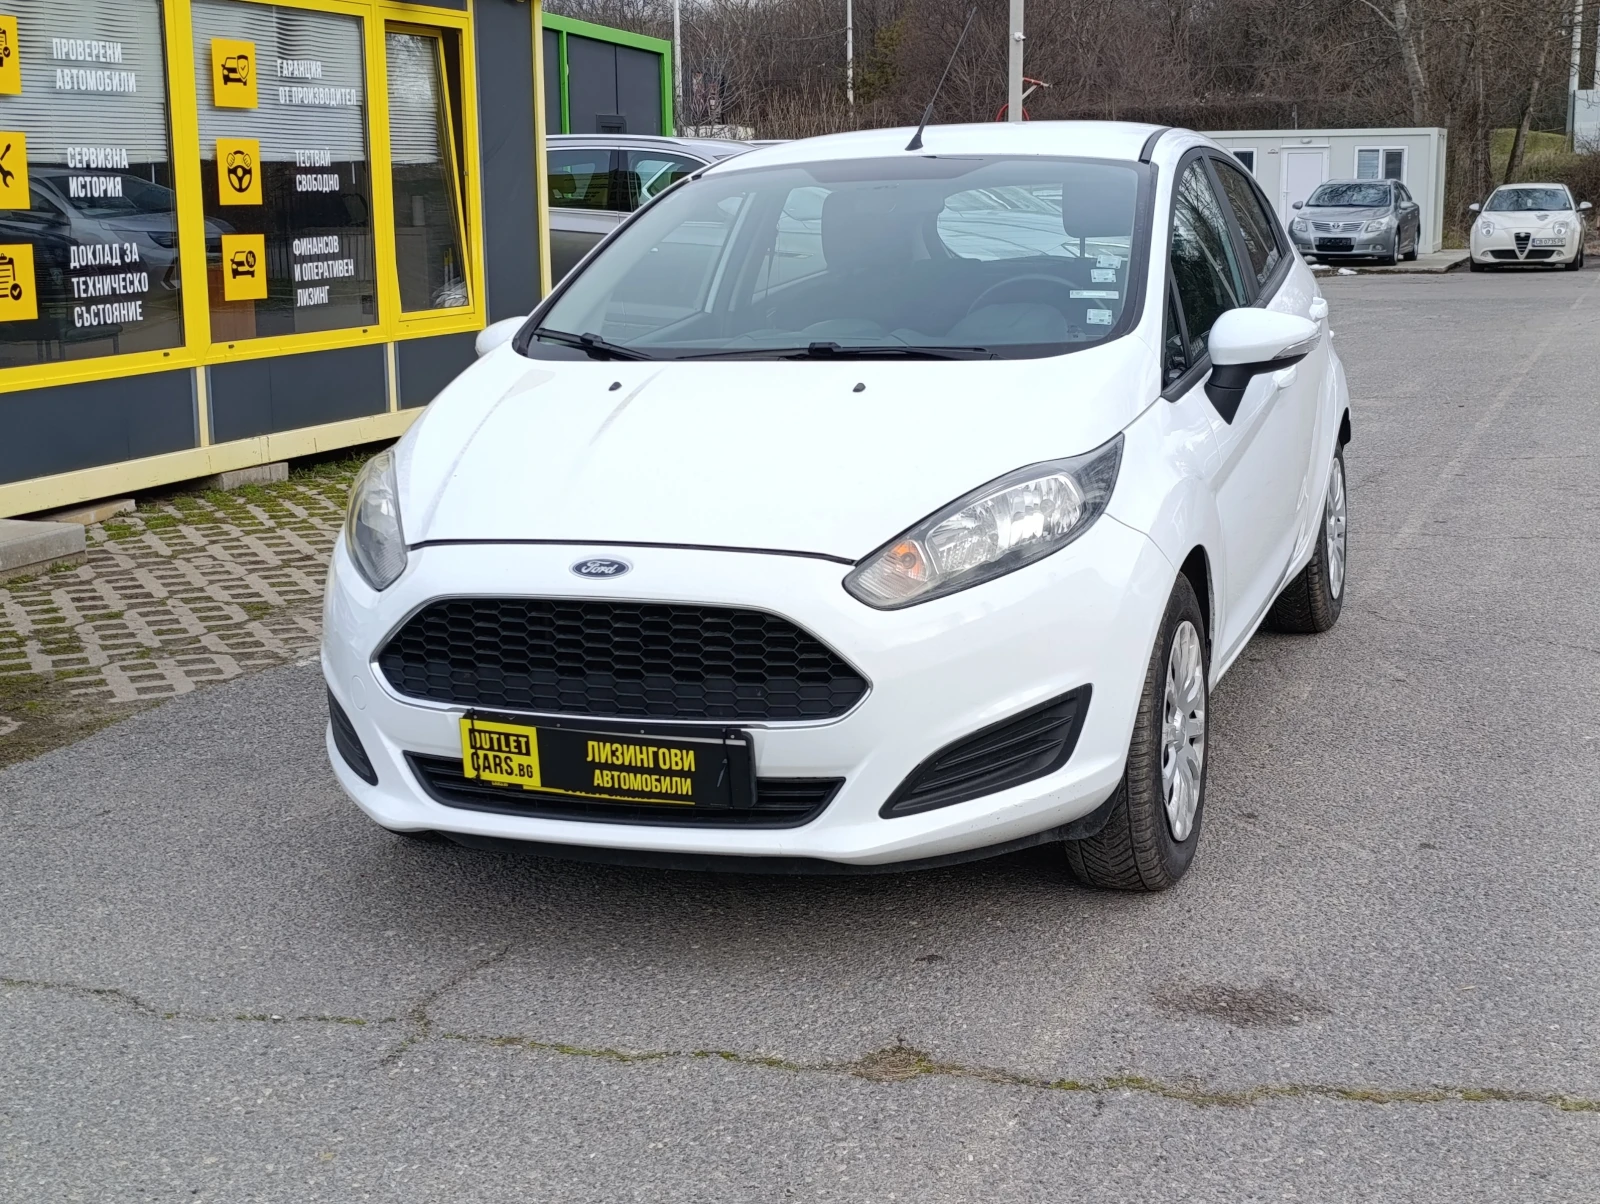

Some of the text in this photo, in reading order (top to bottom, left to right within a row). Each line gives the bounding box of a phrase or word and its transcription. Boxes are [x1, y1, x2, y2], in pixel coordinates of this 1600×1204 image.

[52, 38, 122, 62] ПРОВЕРЕНИ
[277, 60, 322, 79] ГАРАНЦИЯ
[56, 69, 136, 93] АВТОМОБИЛИ
[279, 86, 357, 106] ОТ ПРОИЗВОДИТЕЛ
[67, 147, 129, 169] СЕРВИЗНА
[295, 147, 331, 167] ТЕСТВАЙ
[69, 177, 122, 198] ИСТОРИЯ
[296, 174, 339, 192] СВОБОДНО
[70, 243, 139, 269] ДОКЛАД ЗА
[293, 235, 339, 256] ФИНАНСОВ
[294, 258, 354, 282] И ОПЕРАТИВЕН
[71, 272, 149, 298] ТЕХНИЧЕСКО
[297, 285, 330, 307] ЛИЗИНГ
[74, 301, 143, 327] СЪСТОЯНИЕ
[581, 560, 619, 574] Ford
[586, 740, 695, 772] ЛИЗИНГОВИ
[593, 769, 692, 796] АВТОМОБИЛИ
